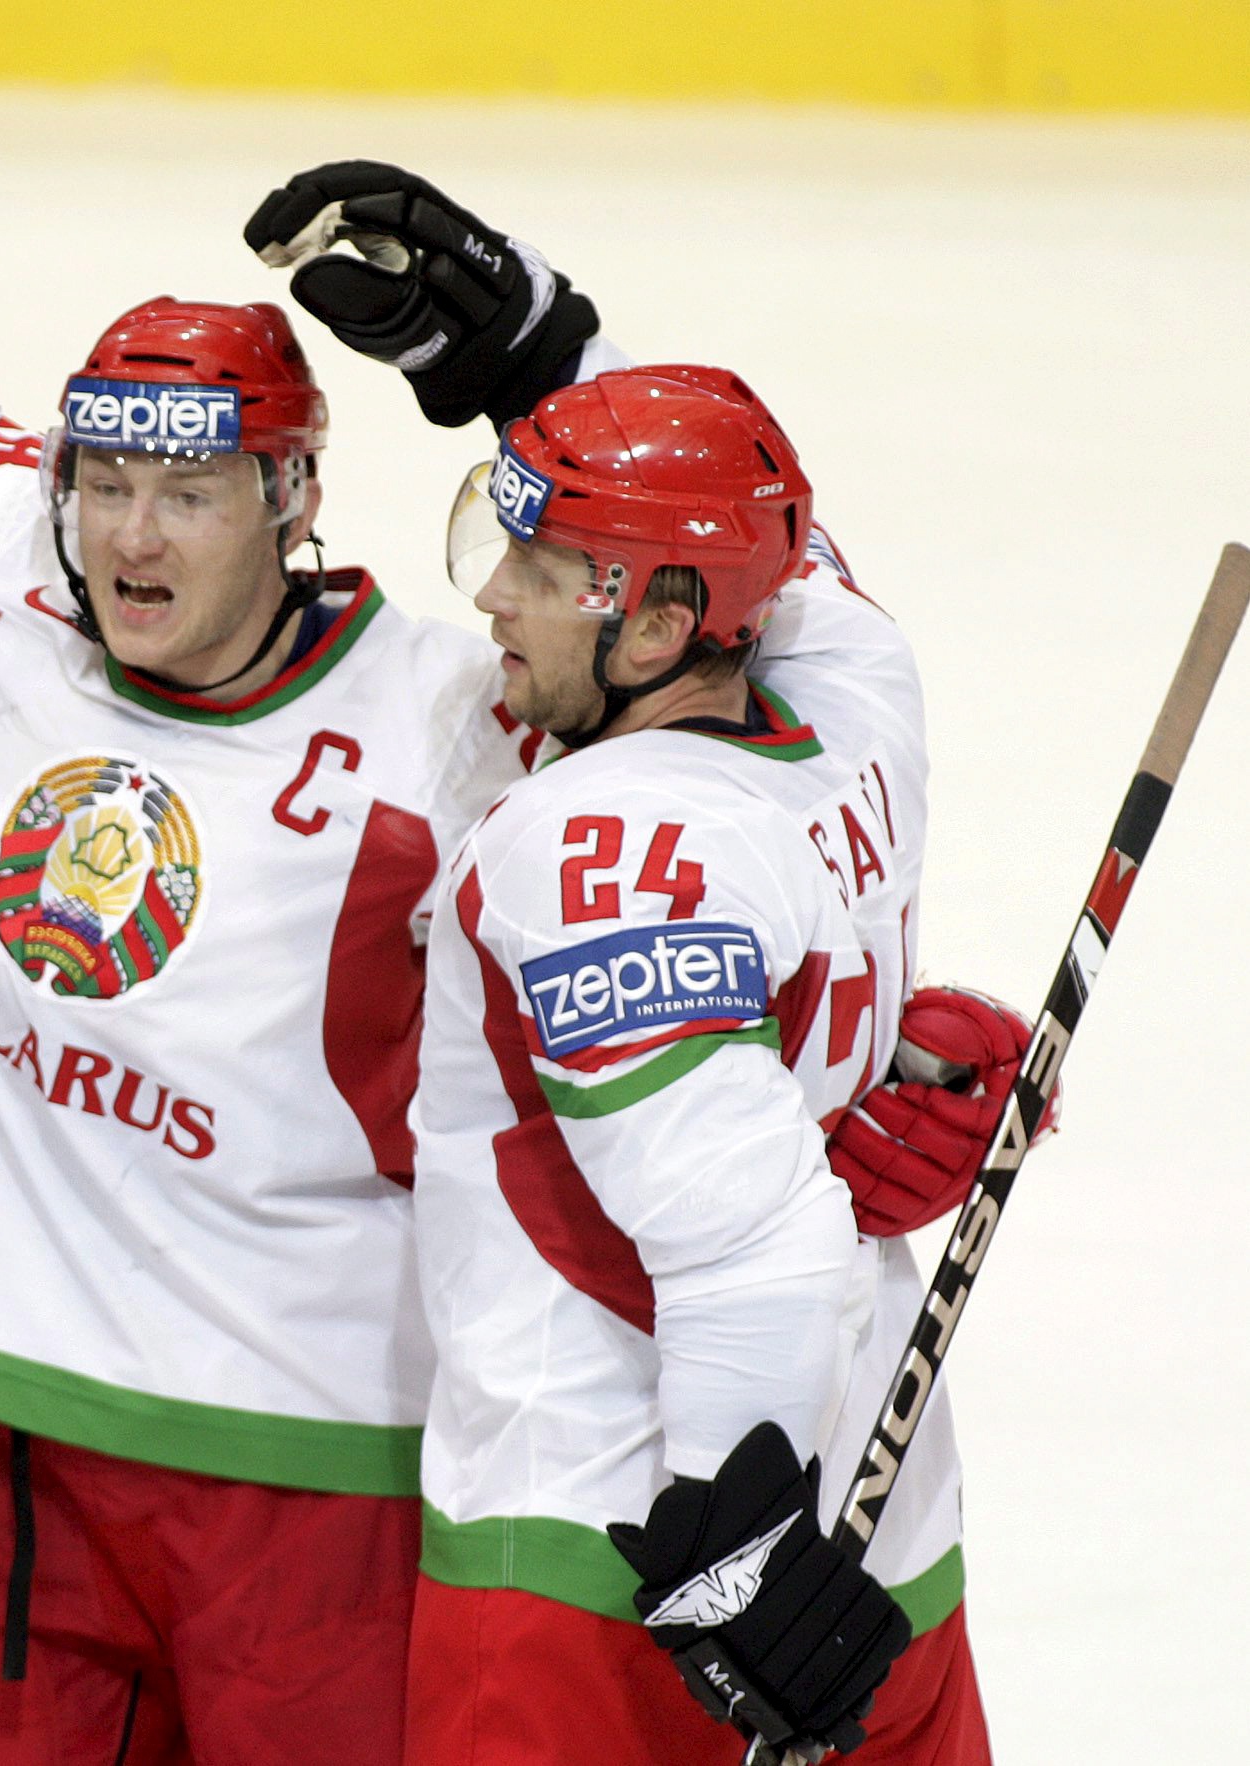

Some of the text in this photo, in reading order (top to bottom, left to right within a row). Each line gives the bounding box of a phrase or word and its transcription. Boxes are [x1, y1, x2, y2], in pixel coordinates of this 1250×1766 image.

[464, 233, 502, 273] M-1
[68, 391, 234, 443] zepter
[273, 730, 363, 836] C
[560, 814, 707, 925] 24
[531, 936, 756, 1028] zepter
[636, 995, 762, 1016] INTERNATIONAL
[845, 1010, 1070, 1543] EASTON
[703, 1661, 745, 1717] M-1
